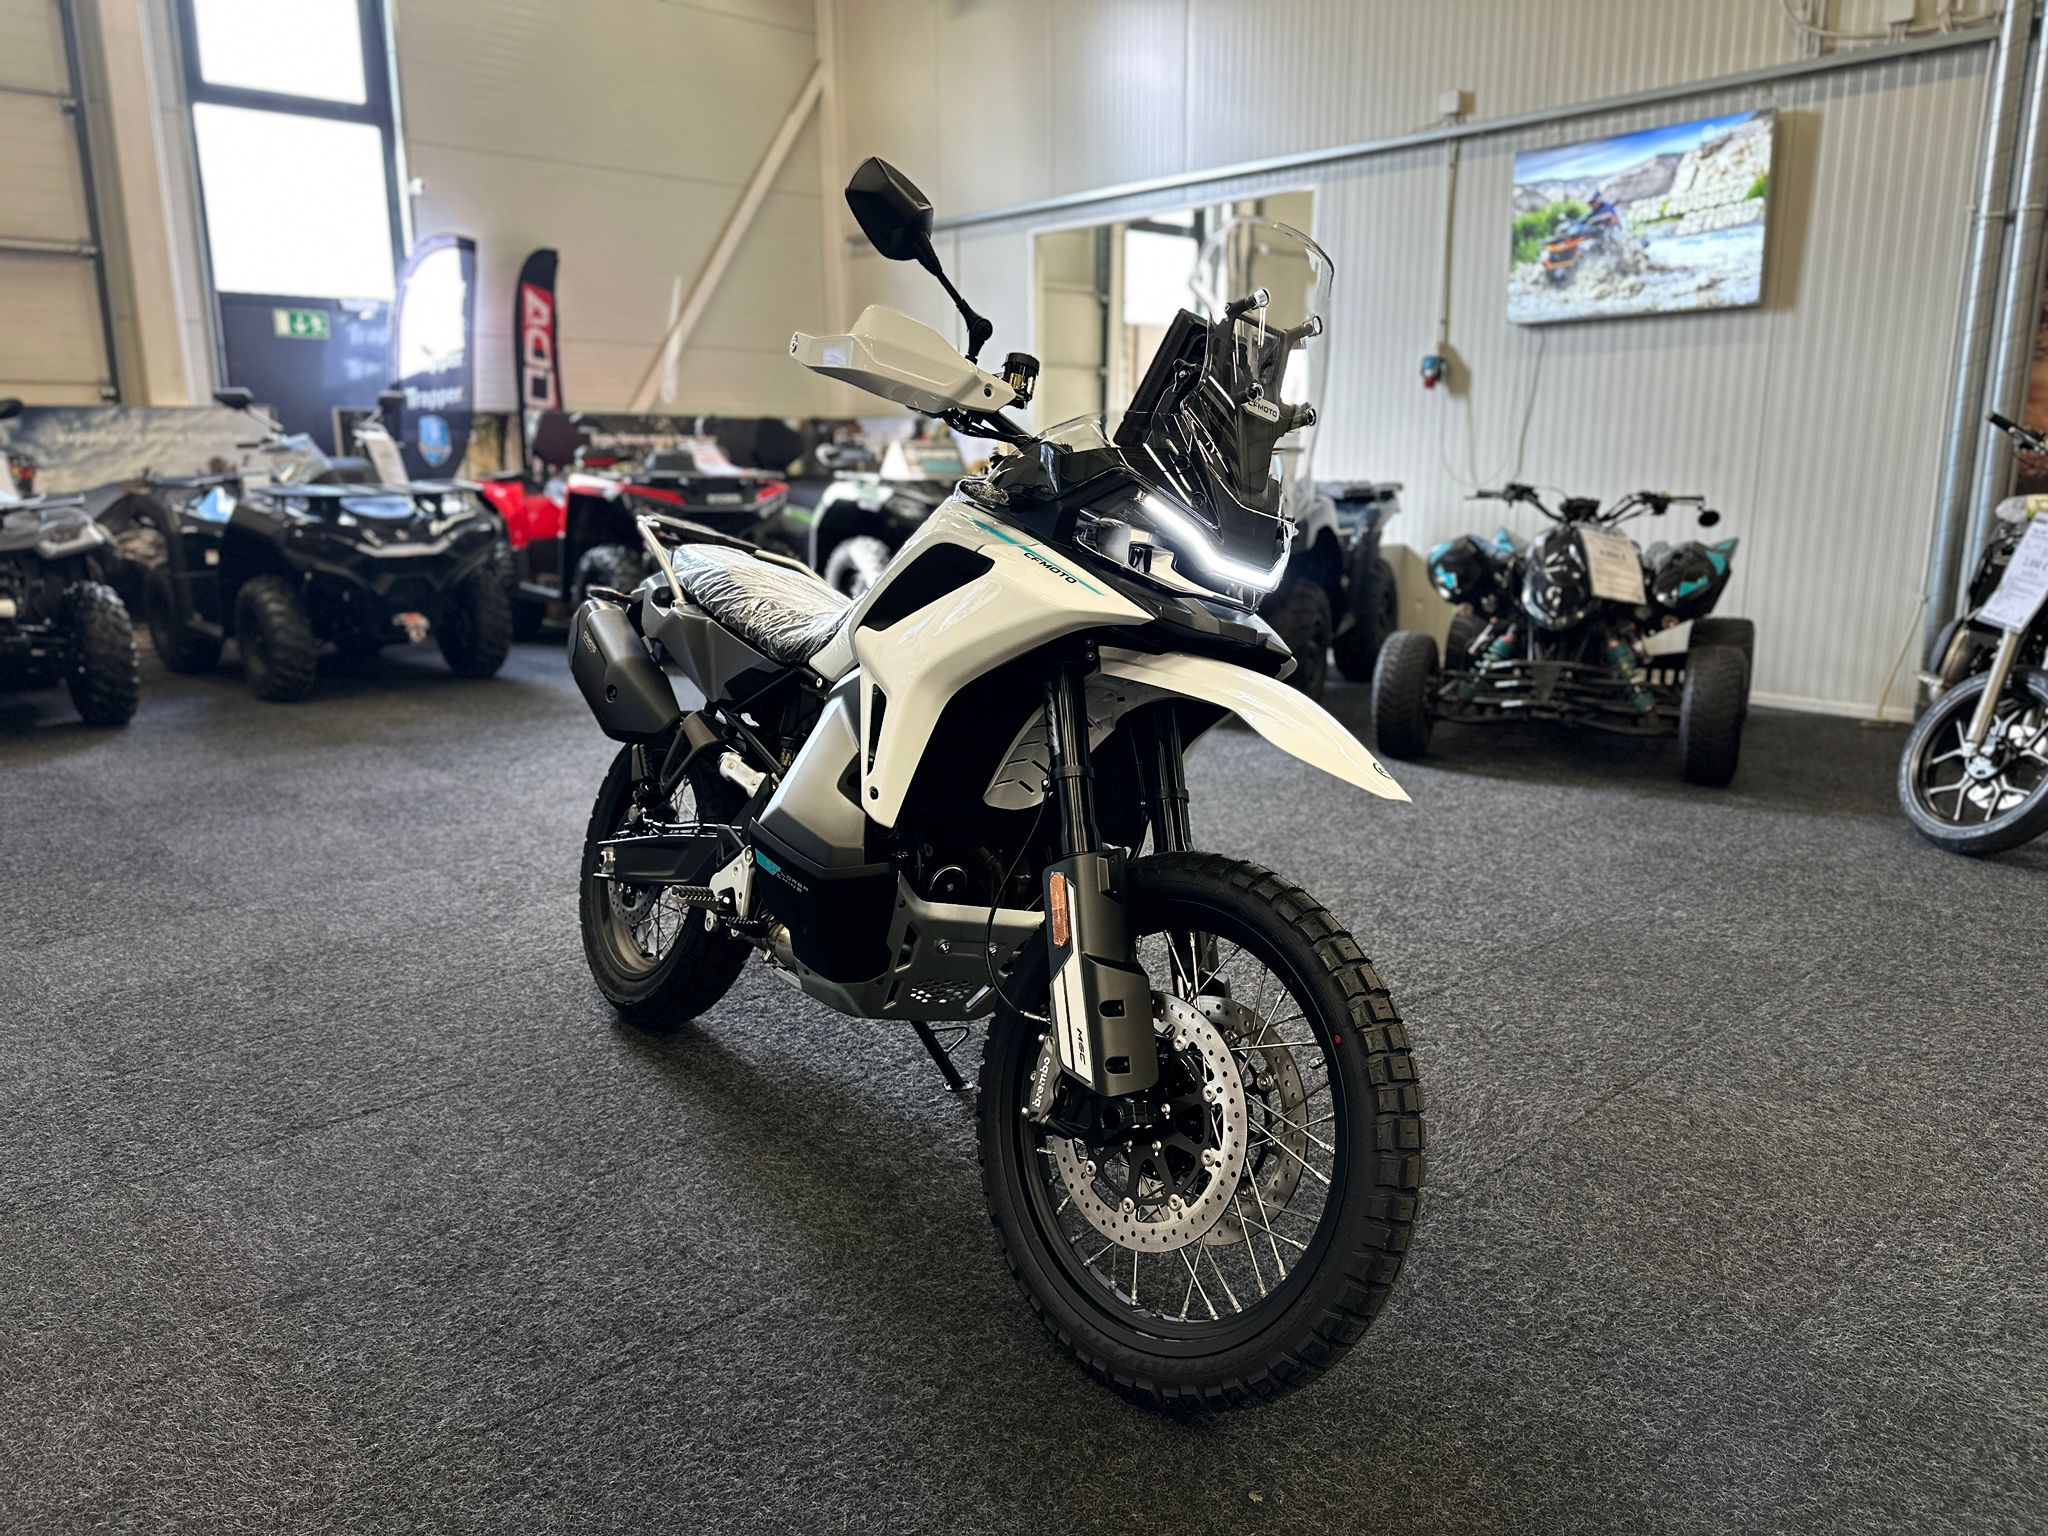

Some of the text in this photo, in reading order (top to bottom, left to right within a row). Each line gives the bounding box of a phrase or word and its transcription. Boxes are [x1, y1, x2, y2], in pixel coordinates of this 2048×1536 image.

[1023, 552, 1077, 584] CFMOTO
[1076, 1027, 1087, 1066] MSC
[1031, 1055, 1051, 1108] brembo
